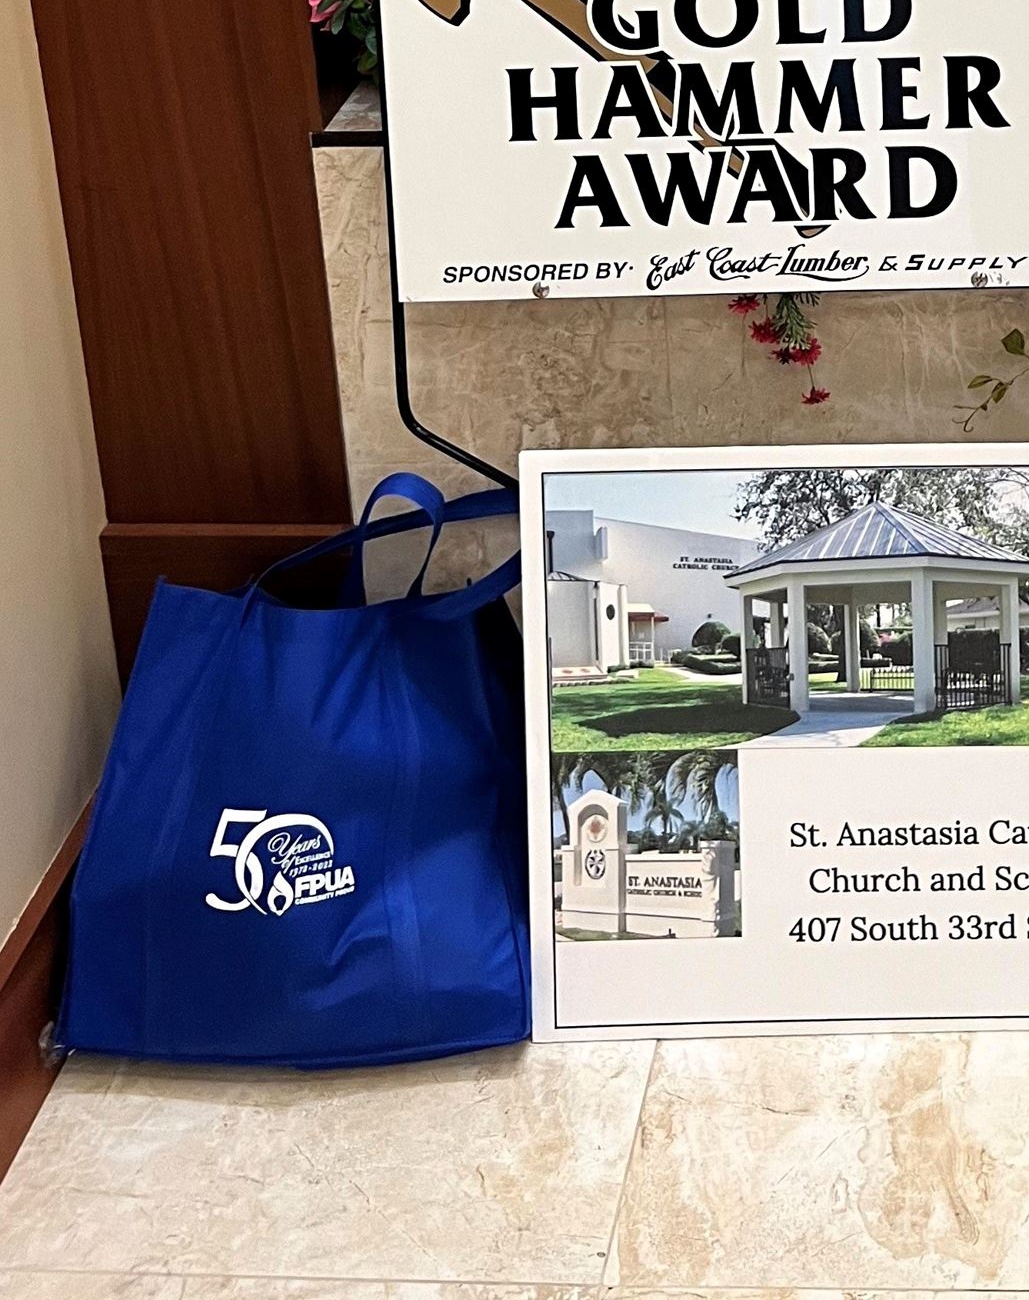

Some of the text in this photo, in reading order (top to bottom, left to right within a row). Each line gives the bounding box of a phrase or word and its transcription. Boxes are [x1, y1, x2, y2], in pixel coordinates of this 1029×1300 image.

[505, 55, 1011, 142] HAMMER
[554, 146, 959, 229] AWARD
[443, 263, 589, 283] SPONSORED
[646, 249, 701, 290] East
[706, 246, 781, 281] Coast
[776, 244, 870, 282] Lumber
[878, 256, 898, 271] &
[905, 254, 1028, 271] SUPPLY
[267, 832, 321, 865] Years
[789, 822, 828, 847] St.
[836, 820, 980, 847] Anastasia
[205, 808, 335, 915] 50
[294, 865, 355, 899] FPUA
[643, 876, 702, 889] ANASTASIA
[808, 866, 922, 894] Church
[929, 865, 986, 891] and
[788, 916, 842, 942] 407
[850, 915, 939, 942] South
[948, 913, 1018, 940] 33rd
